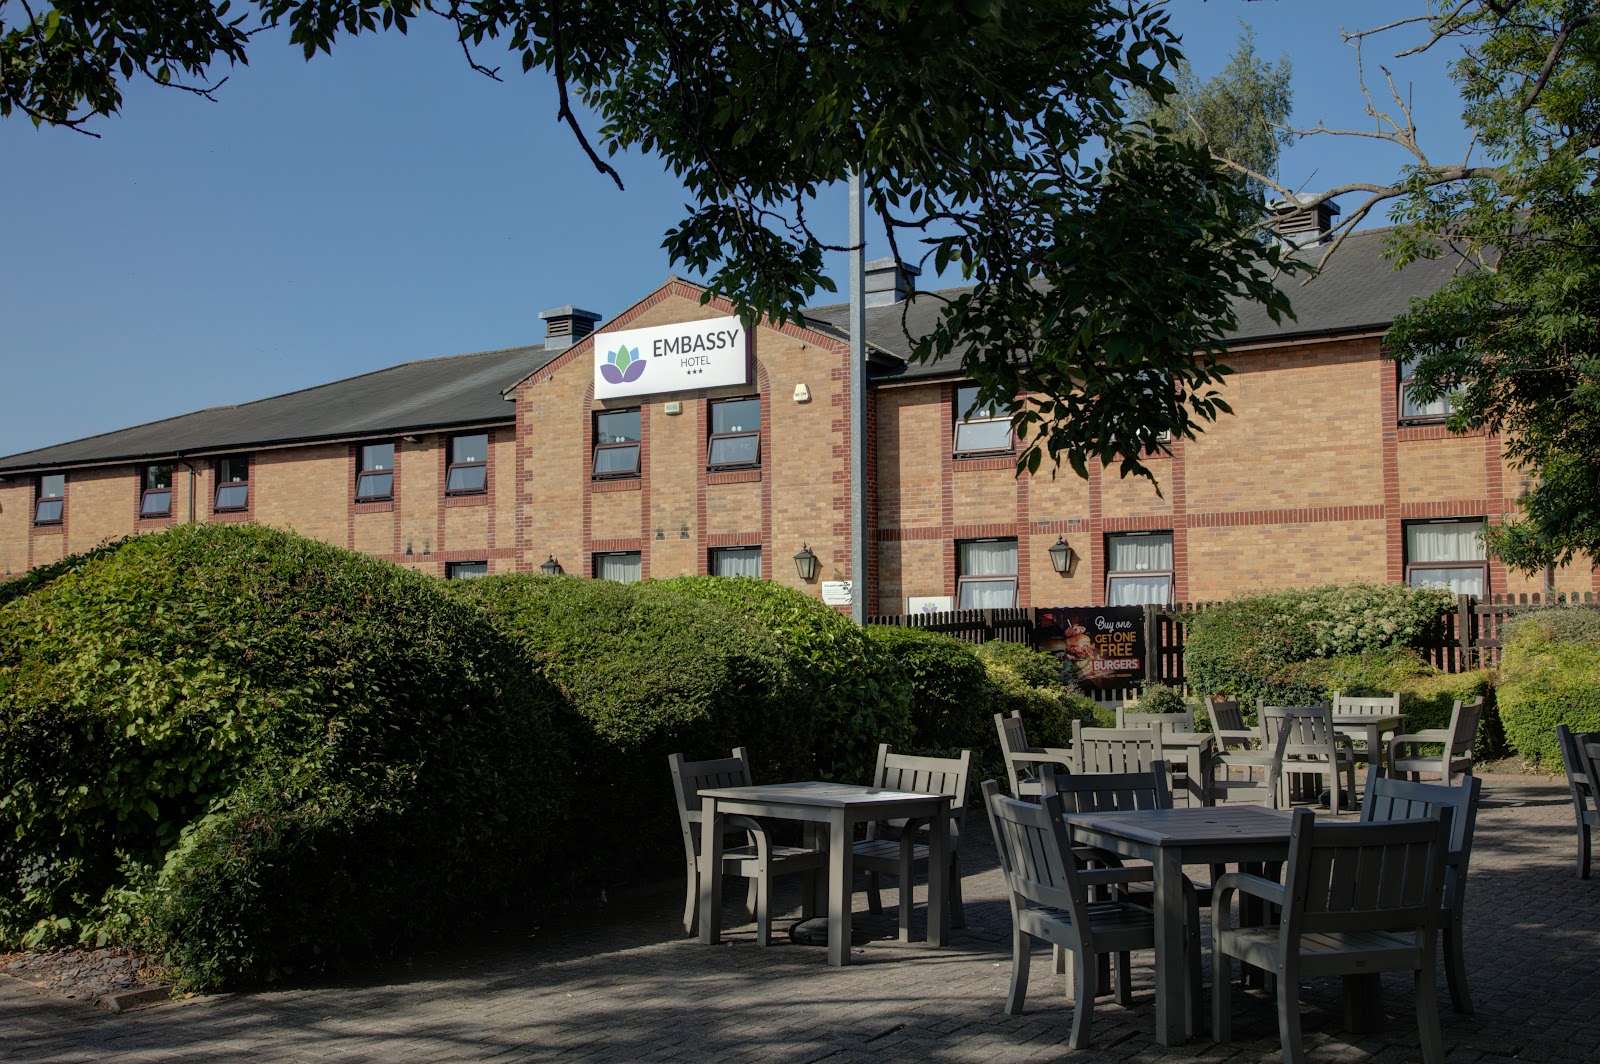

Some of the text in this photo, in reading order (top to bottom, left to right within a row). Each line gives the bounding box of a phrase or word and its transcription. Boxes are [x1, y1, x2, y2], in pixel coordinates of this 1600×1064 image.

[653, 329, 739, 357] EMBASSY
[680, 356, 711, 368] HOTEL
[1095, 616, 1132, 633] Buy one
[1095, 631, 1136, 643] GET ONE
[1100, 643, 1133, 657] FREE
[1093, 659, 1138, 671] BURGERS
